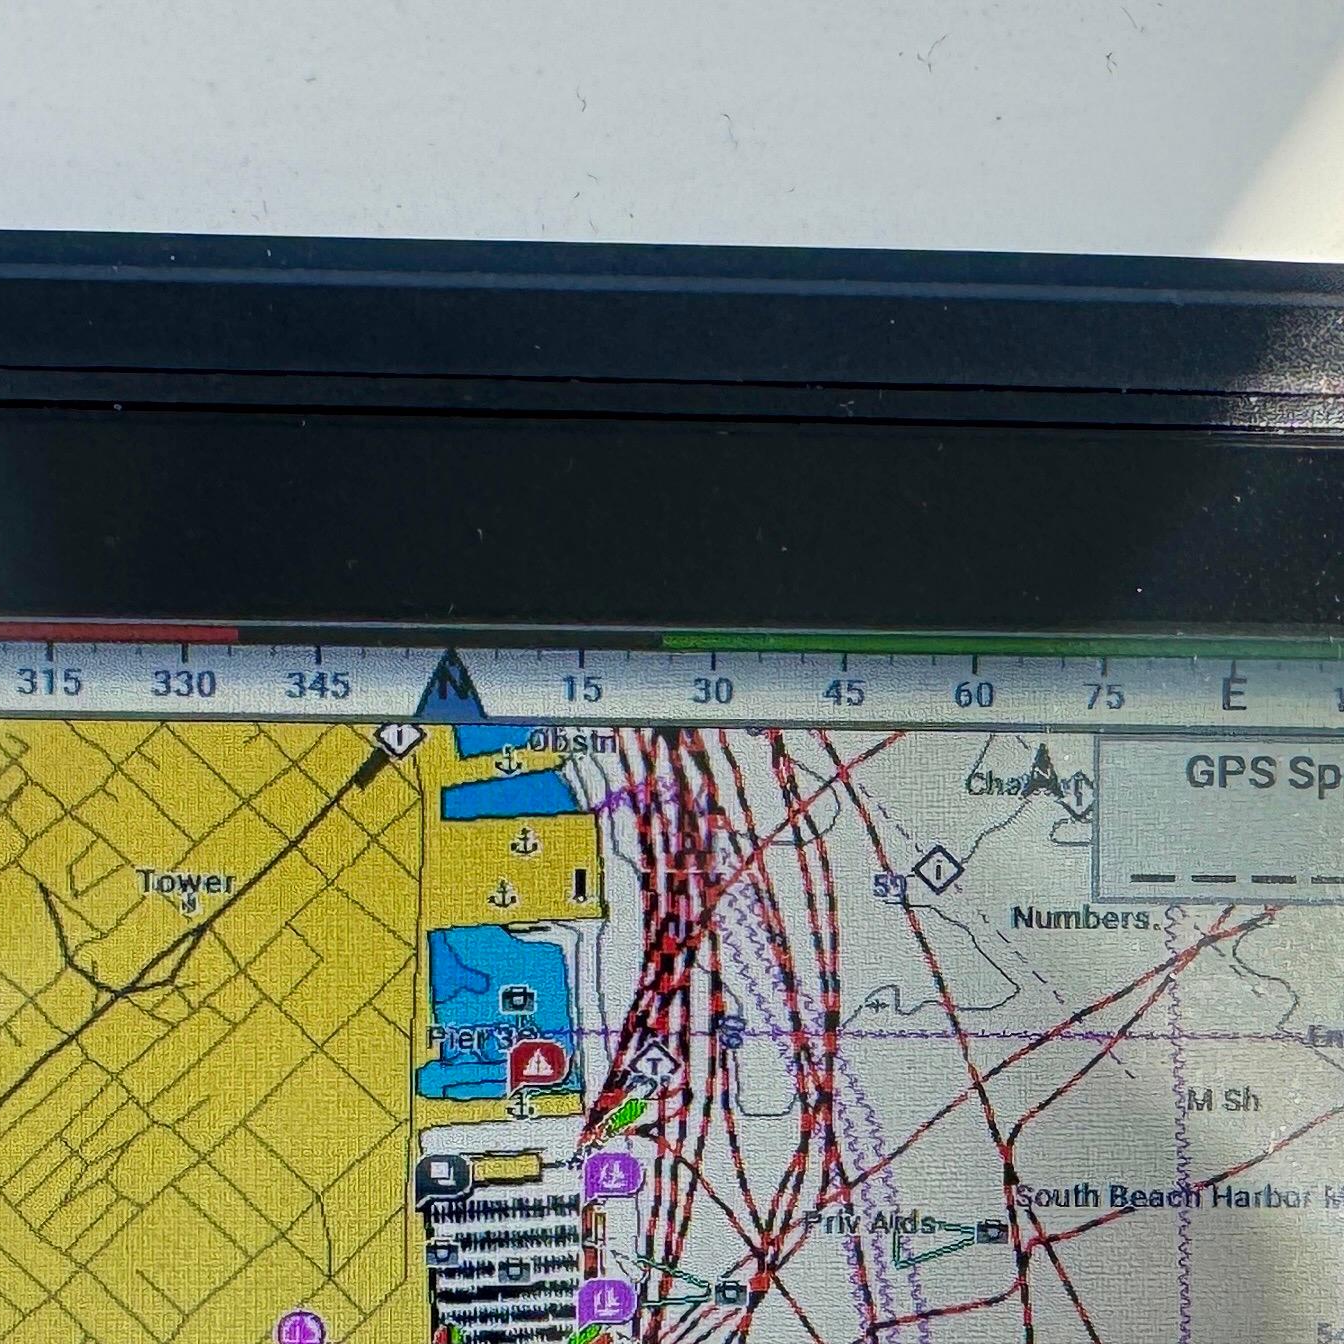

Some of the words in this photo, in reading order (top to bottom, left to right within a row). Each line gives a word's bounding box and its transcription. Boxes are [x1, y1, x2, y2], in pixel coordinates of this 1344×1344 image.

[16, 669, 82, 696] 315
[153, 670, 217, 697] 330
[286, 671, 350, 698] 345
[563, 675, 603, 703] 15
[692, 676, 734, 705] 30
[822, 679, 867, 707] 45
[954, 681, 995, 708] 60
[1085, 683, 1126, 710] 75
[1221, 676, 1249, 711] E
[1185, 755, 1278, 791] GPS
[135, 868, 237, 894] Tower
[1011, 905, 1161, 931] Numbers.
[427, 1025, 486, 1050] Pier
[1187, 1088, 1213, 1112] M
[1224, 1086, 1262, 1112] Sh
[1015, 1183, 1099, 1209] South
[1109, 1183, 1202, 1209] Beach
[1211, 1184, 1314, 1209] Harbor
[802, 1210, 861, 1234] Priv
[873, 1209, 936, 1235] Aids
